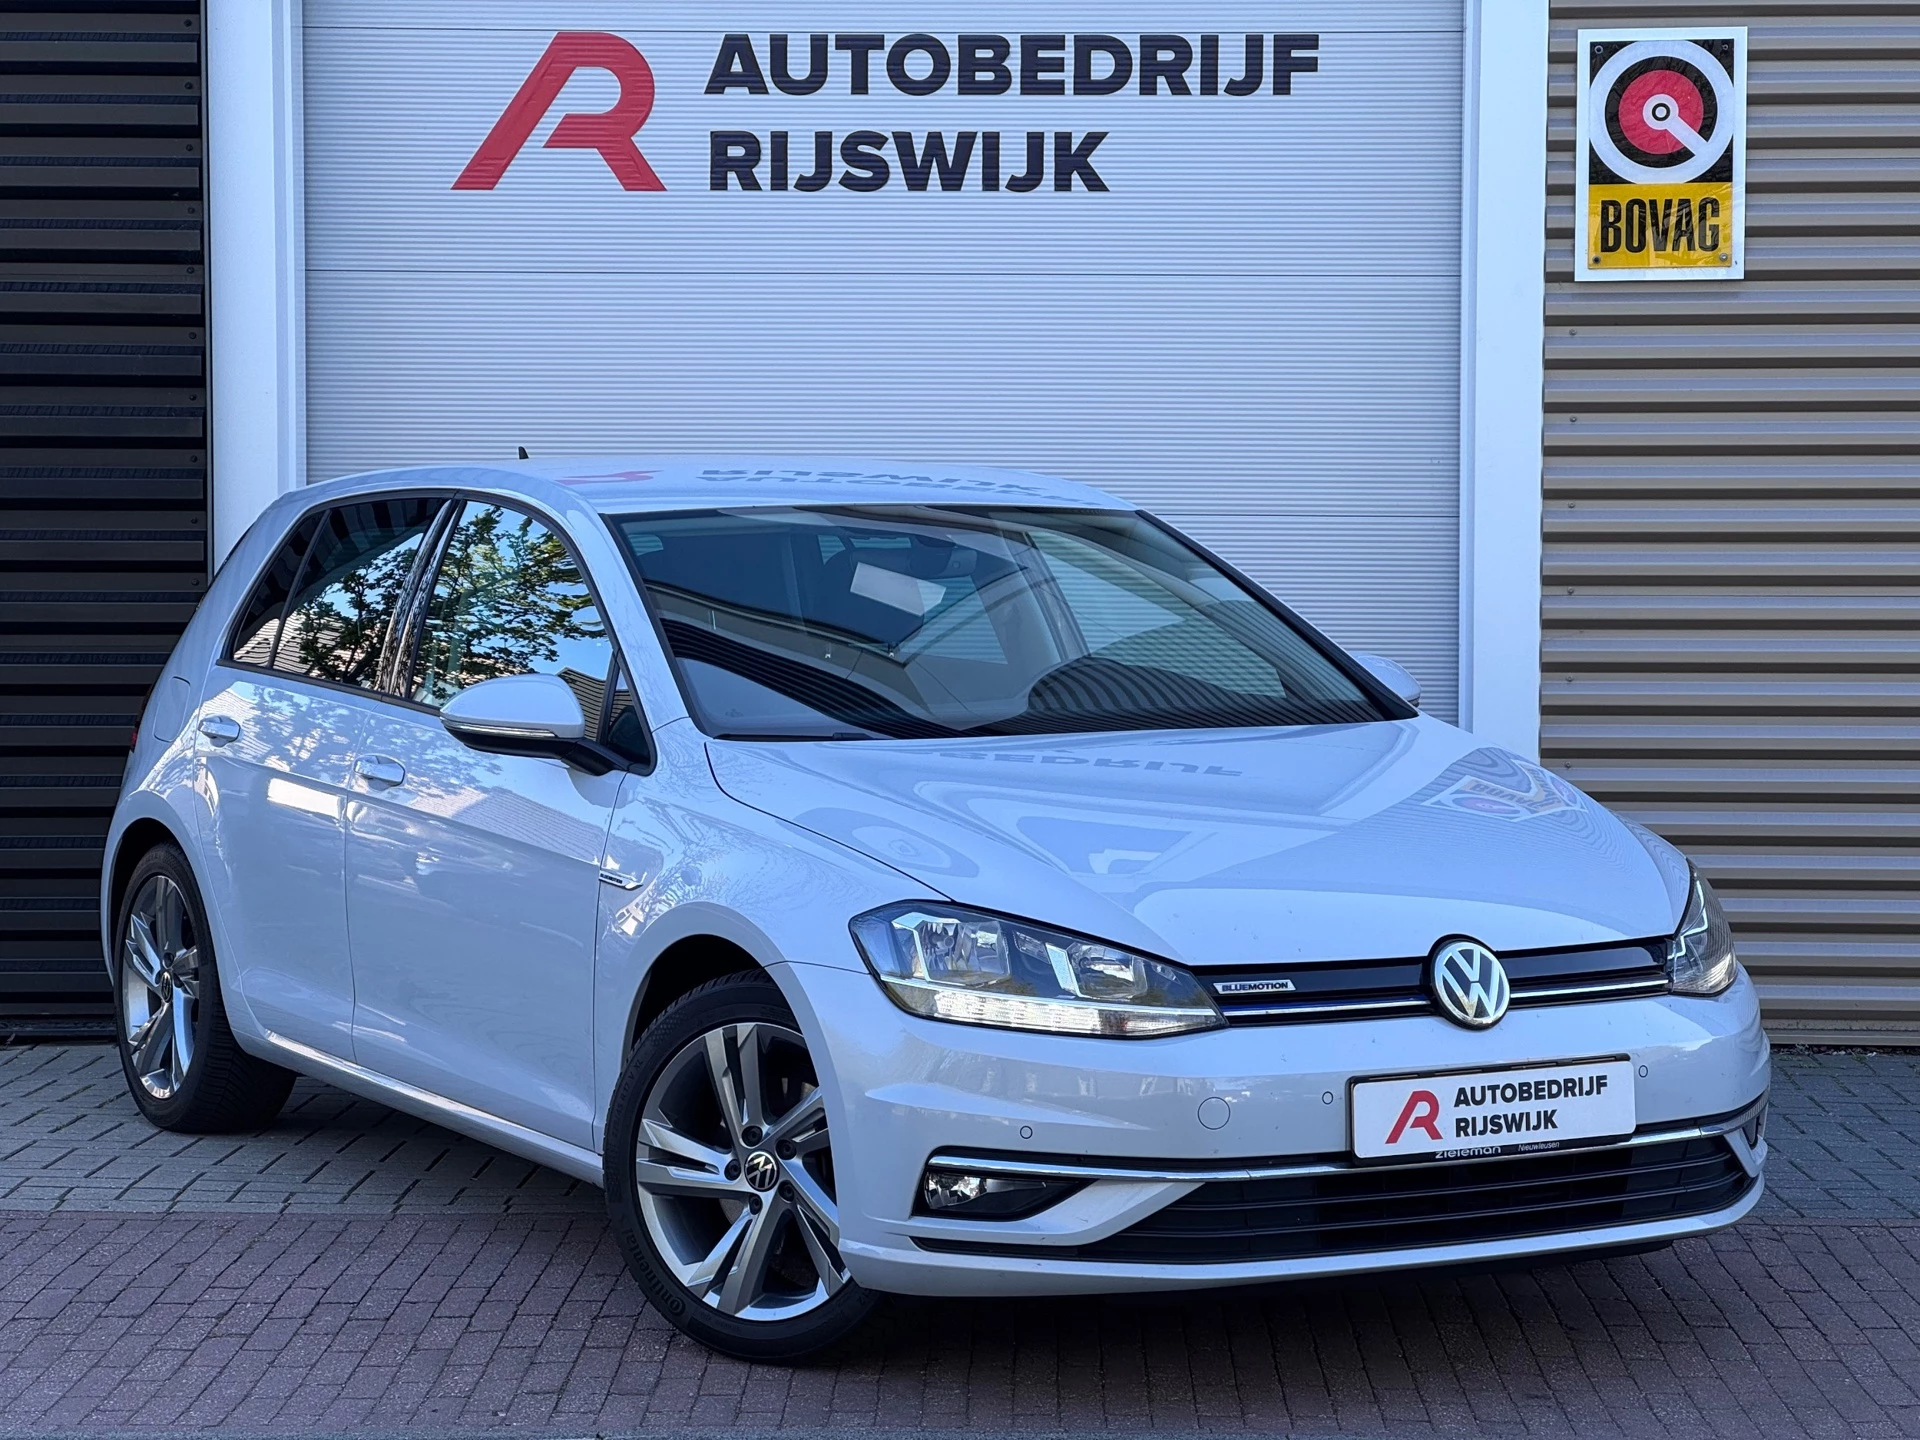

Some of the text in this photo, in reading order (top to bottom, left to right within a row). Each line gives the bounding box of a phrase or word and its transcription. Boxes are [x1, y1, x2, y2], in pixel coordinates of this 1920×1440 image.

[704, 33, 1320, 96] AUTOBEDRIJF
[709, 130, 1110, 192] RIJSWIJK
[1600, 196, 1720, 253] BOVAG
[1221, 981, 1289, 992] BLUEMOTION
[1453, 1075, 1609, 1108] AUTOBEDRIJF
[1454, 1109, 1558, 1138] RIJSWIJK
